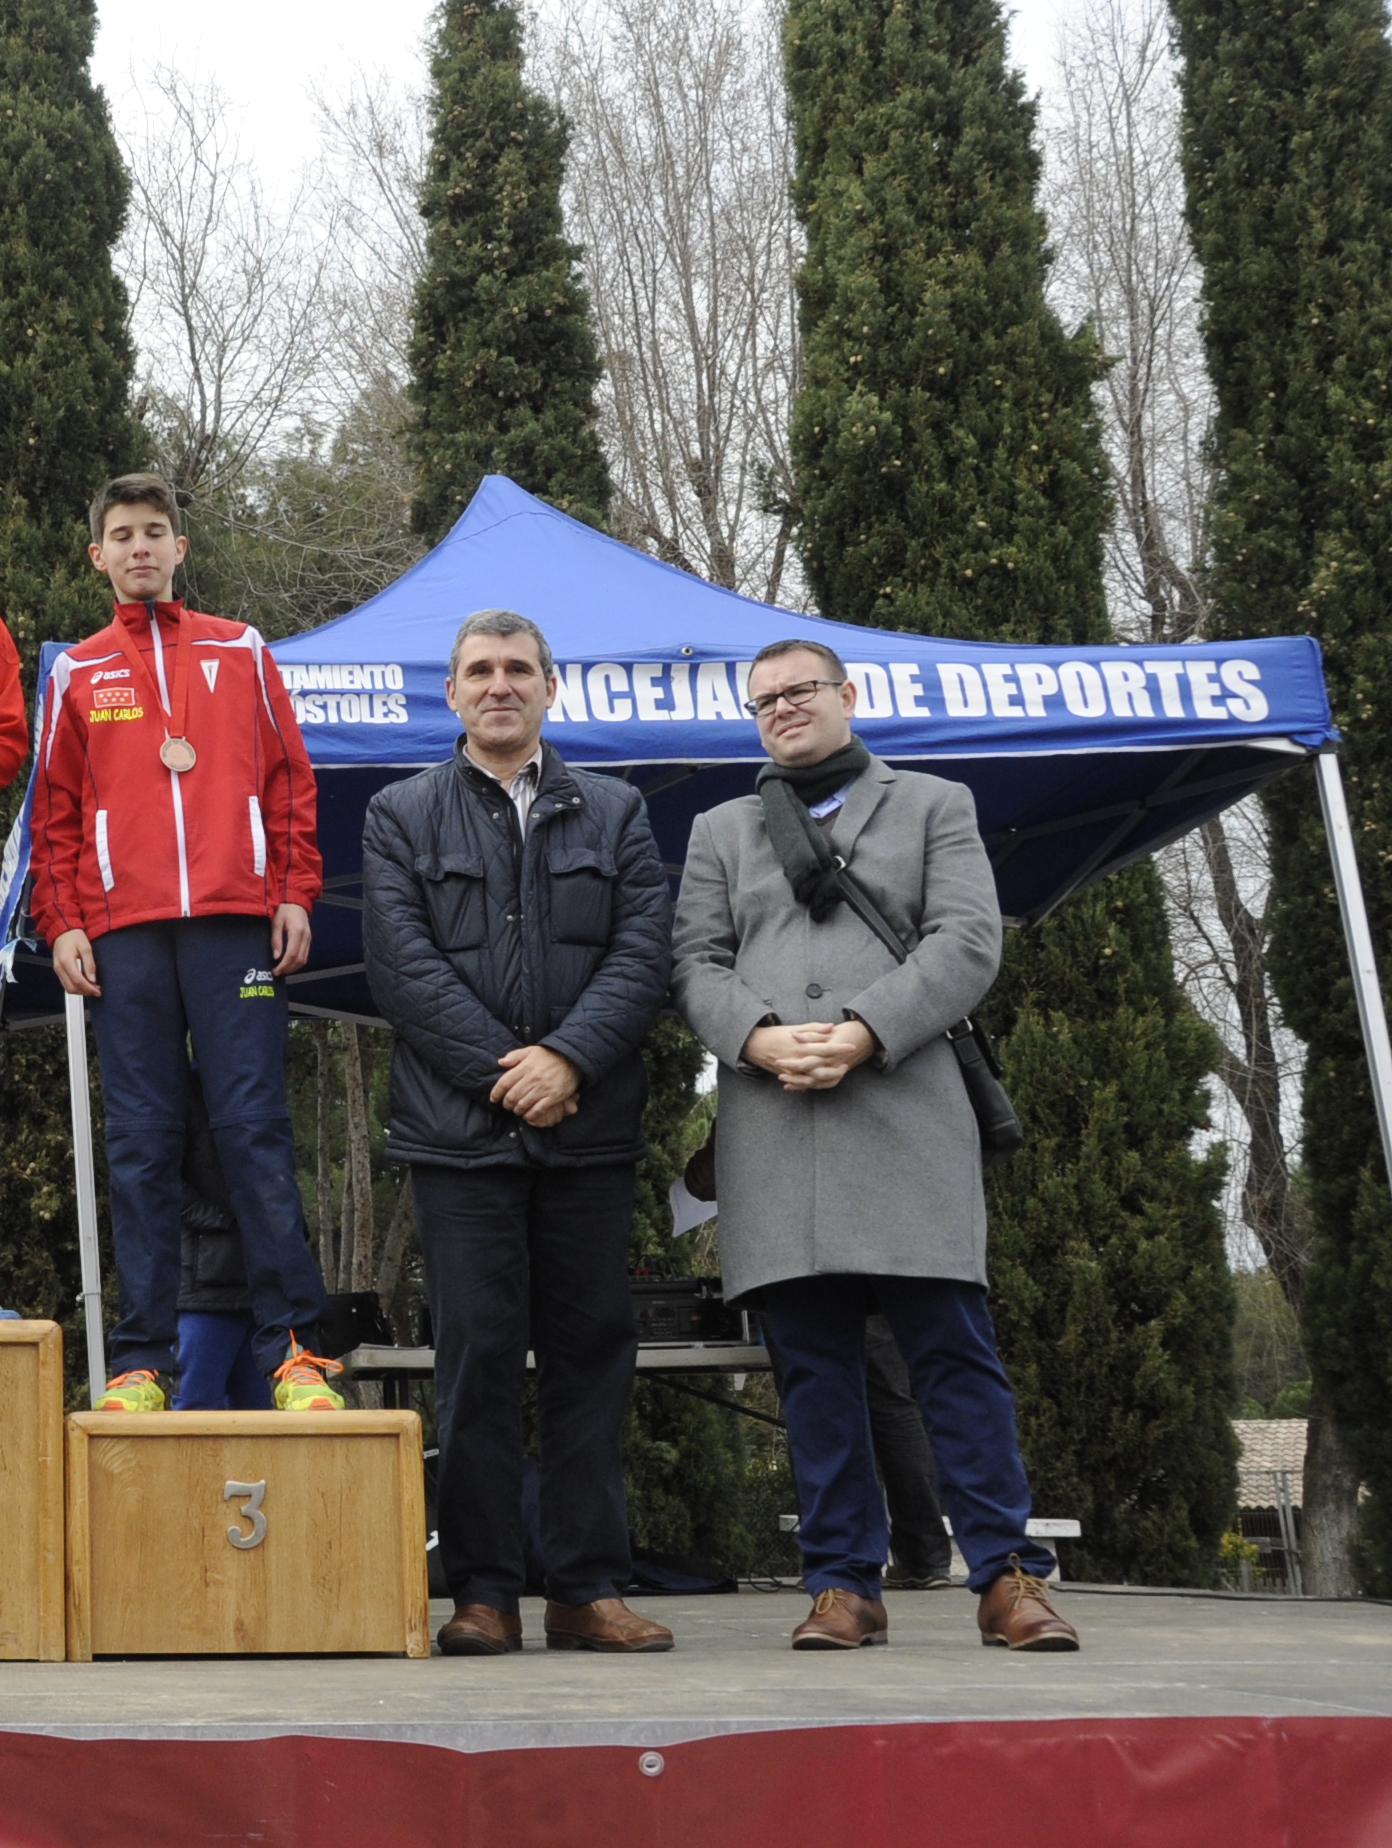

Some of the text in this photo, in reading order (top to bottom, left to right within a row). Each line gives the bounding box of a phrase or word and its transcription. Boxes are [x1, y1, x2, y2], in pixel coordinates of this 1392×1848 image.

[276, 663, 405, 690] TAMIENTO
[844, 662, 932, 719] DE
[935, 658, 1269, 723] DEPORTES
[89, 706, 144, 723] JUAN CARLOS
[289, 687, 409, 725] ÓSTOLES
[223, 1479, 268, 1551] 3
